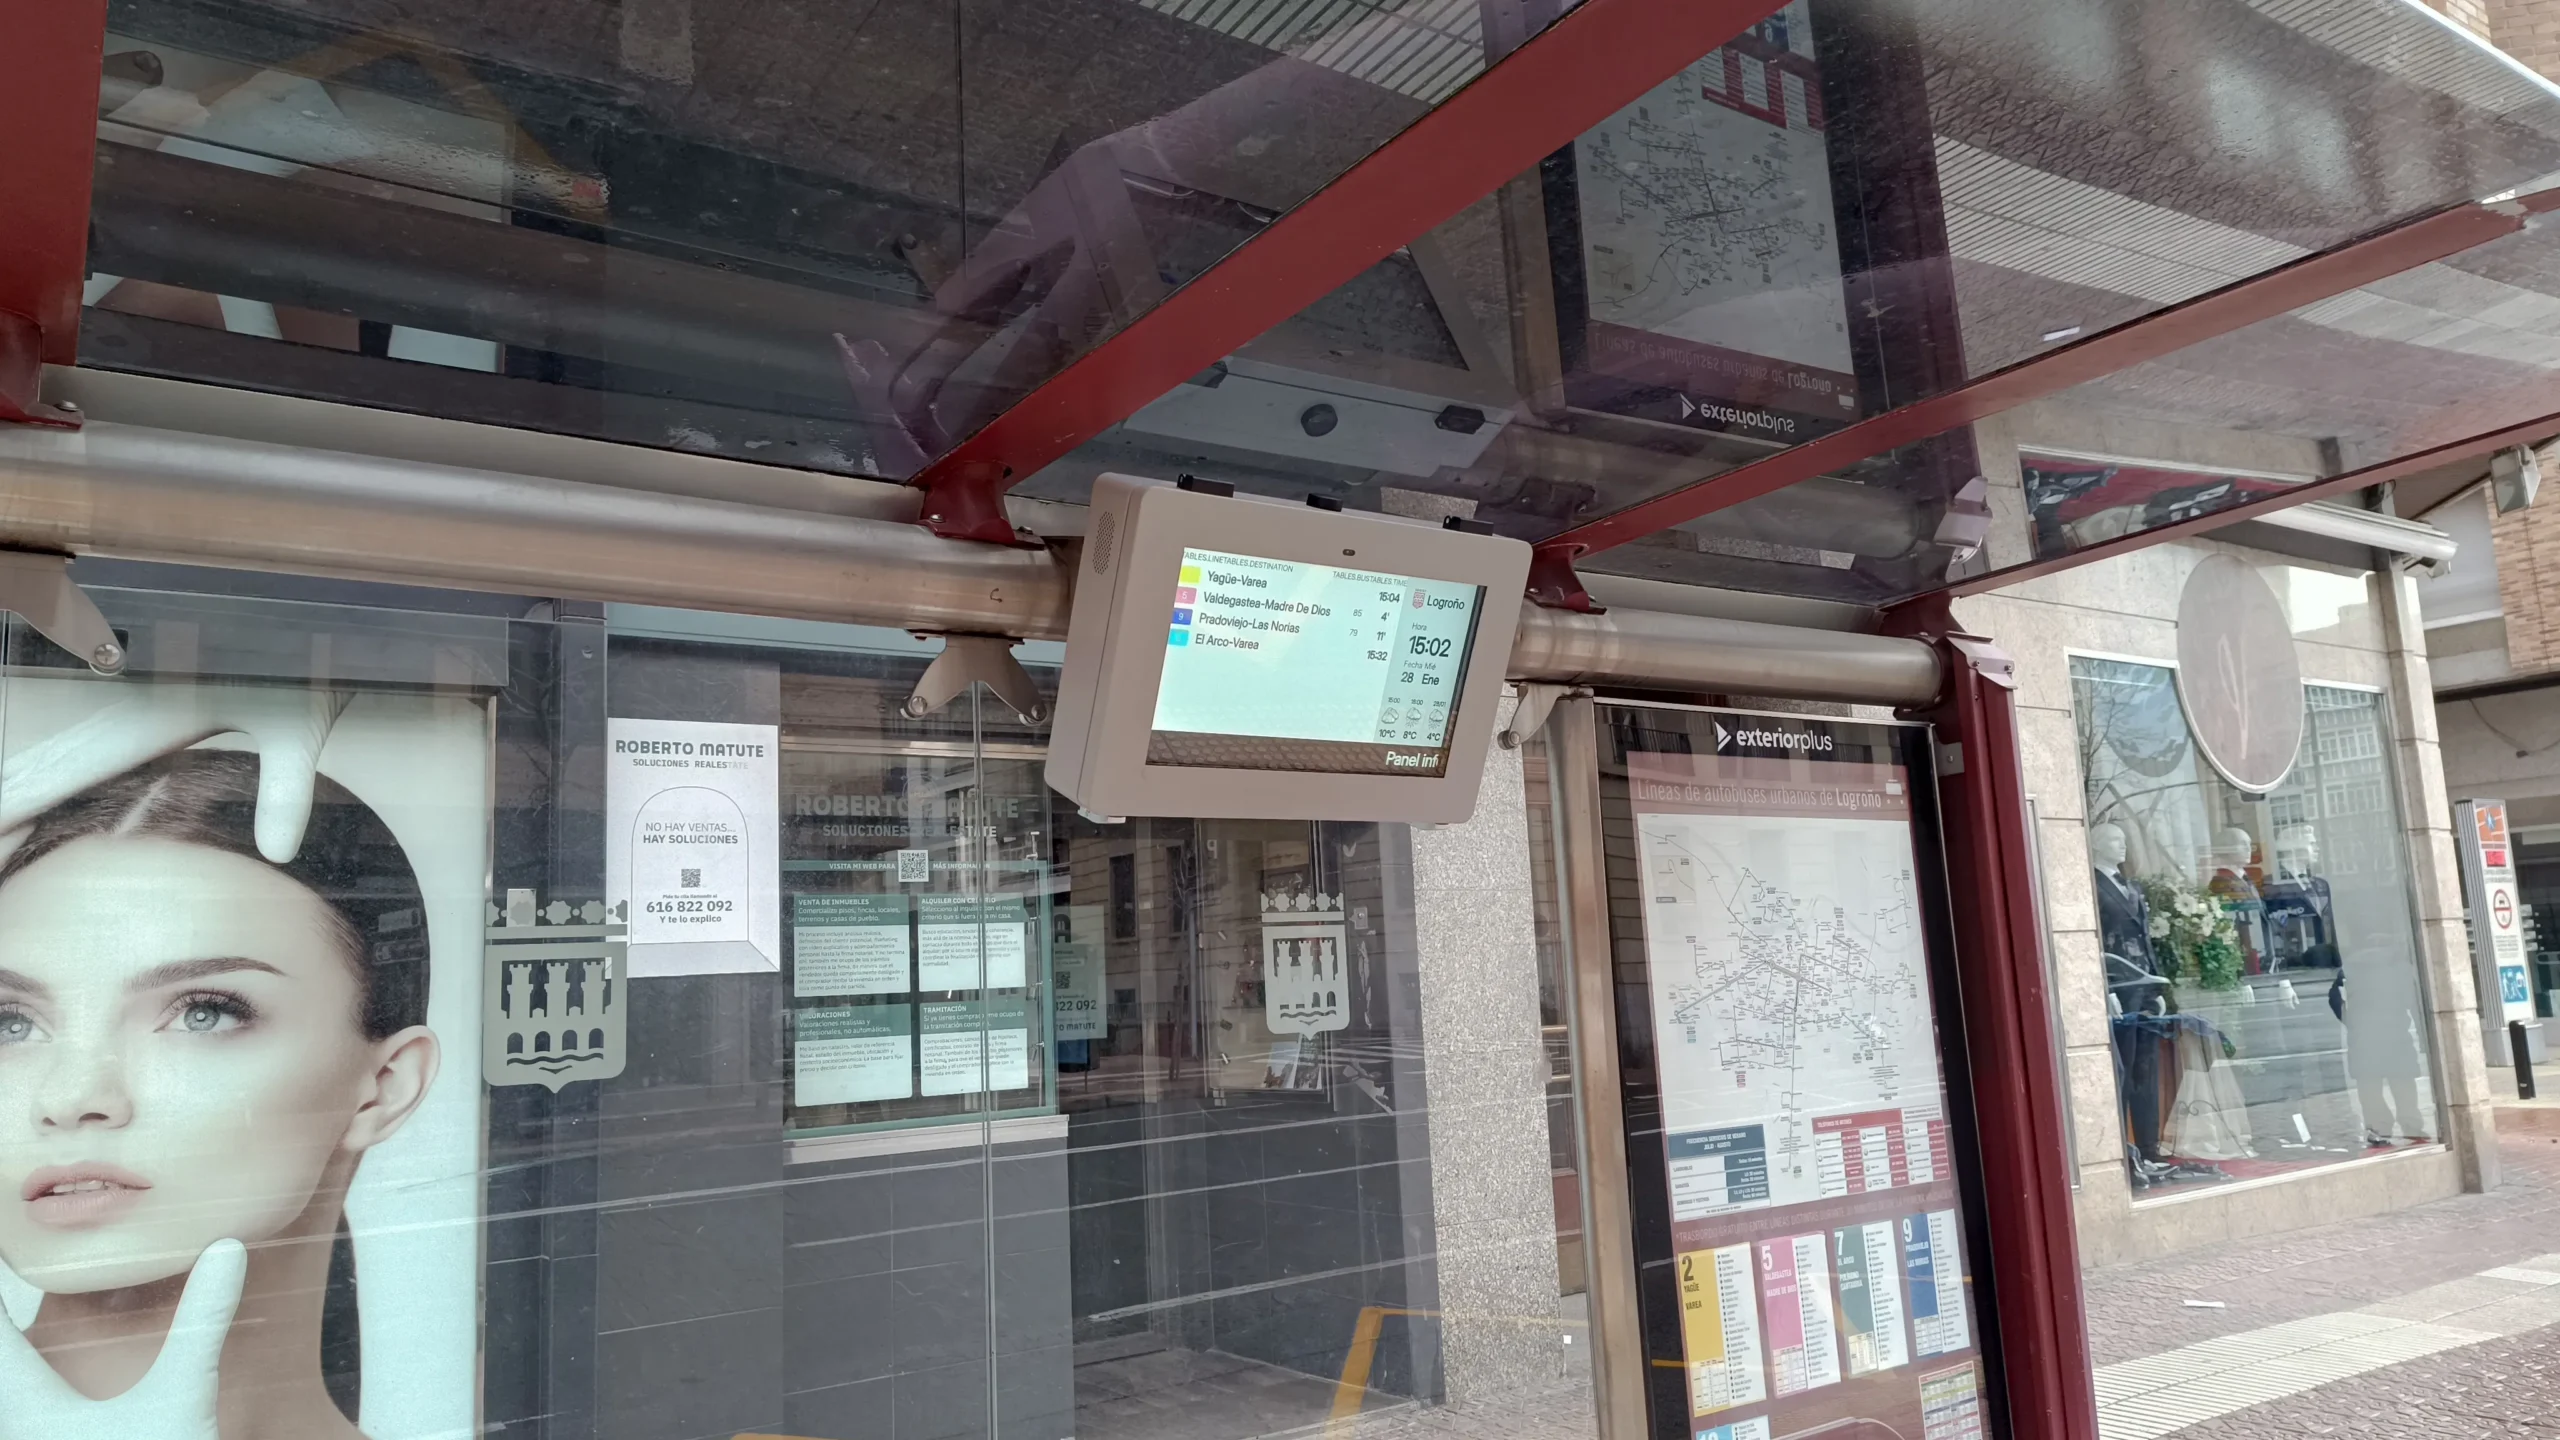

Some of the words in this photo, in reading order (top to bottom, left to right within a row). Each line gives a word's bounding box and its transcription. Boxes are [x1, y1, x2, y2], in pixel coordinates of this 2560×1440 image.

[1208, 570, 1267, 588] Yagüe-Varea
[1182, 591, 1188, 600] 5
[1379, 591, 1401, 604] 15:04
[1203, 591, 1294, 612] Valdegastea-Madre
[1296, 602, 1309, 614] De
[1311, 604, 1331, 617] Dios
[1427, 595, 1465, 610] Logroño
[1178, 612, 1184, 621] 9
[1353, 609, 1363, 617] 85
[1199, 612, 1269, 631] Pradoviejo-Las
[1271, 620, 1300, 633] Norias
[1412, 622, 1427, 631] Hora
[1195, 633, 1205, 645] El
[1206, 634, 1259, 650] Arco-Varea
[1409, 635, 1451, 658] 15:02
[1367, 650, 1388, 661] 15:32
[1404, 660, 1423, 670] Fecha
[1400, 671, 1414, 683] 28
[1422, 673, 1440, 686] Ene
[1736, 727, 1833, 753] exteriorplus
[615, 739, 694, 755] ROBERTO
[699, 743, 764, 758] MATUTE
[632, 758, 689, 768] SOLUCIONES
[1385, 750, 1421, 767] Panel
[1421, 753, 1439, 768] inf
[1638, 780, 1681, 800] Líneas
[1685, 783, 1701, 802] de
[1704, 784, 1766, 803] autobuses
[1770, 788, 1816, 805] urbanos
[1819, 789, 1833, 806] de
[1836, 788, 1882, 810] Logroño
[645, 822, 662, 831] NO
[665, 822, 685, 832] HAY
[823, 825, 908, 837] SOLUCIONES
[643, 834, 666, 844] HAY
[668, 834, 739, 844] SOLUCIONES
[933, 861, 947, 869] MÁS
[948, 862, 991, 870] INFORMAN
[646, 901, 673, 913] 616
[677, 901, 703, 912] 822
[707, 900, 733, 912] 092
[799, 898, 820, 906] VENTA
[659, 915, 666, 924] Y
[679, 915, 688, 923] lo
[690, 915, 722, 924] explico
[923, 1005, 967, 1013] TRAMITACIÓN
[1076, 999, 1097, 1011] 092
[799, 1010, 851, 1019] VLORACIONES
[1066, 1022, 1096, 1031] MATUTE
[1902, 1218, 1913, 1243] 9
[1834, 1230, 1844, 1256] 7
[1761, 1245, 1773, 1271] 5
[1681, 1255, 1694, 1282] 2
[1684, 1282, 1700, 1293] YAGÜE
[1686, 1300, 1702, 1310] VAREA
